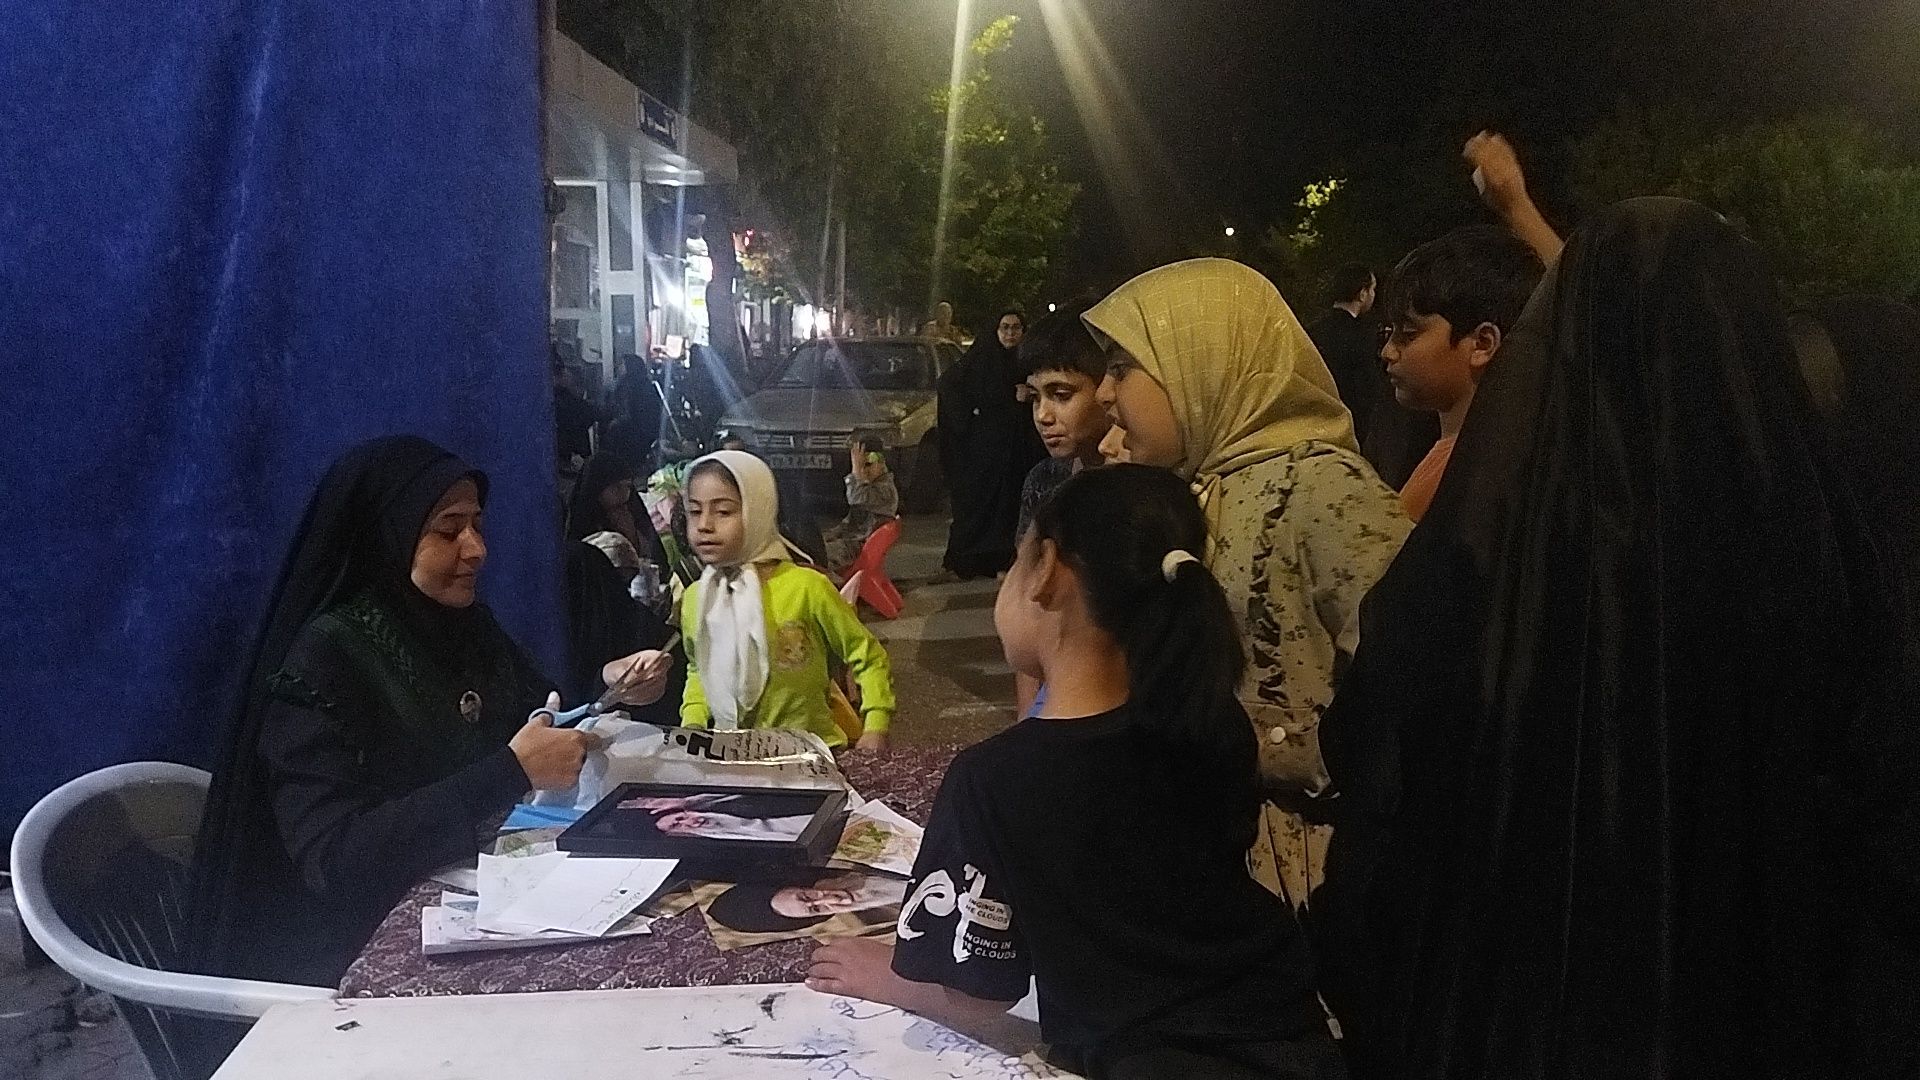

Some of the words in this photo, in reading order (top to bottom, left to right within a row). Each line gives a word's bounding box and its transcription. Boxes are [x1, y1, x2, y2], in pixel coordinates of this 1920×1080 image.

[977, 910, 1007, 924] CLOUDS
[1000, 941, 1012, 950] IN
[974, 947, 1017, 960] CLOUDS
